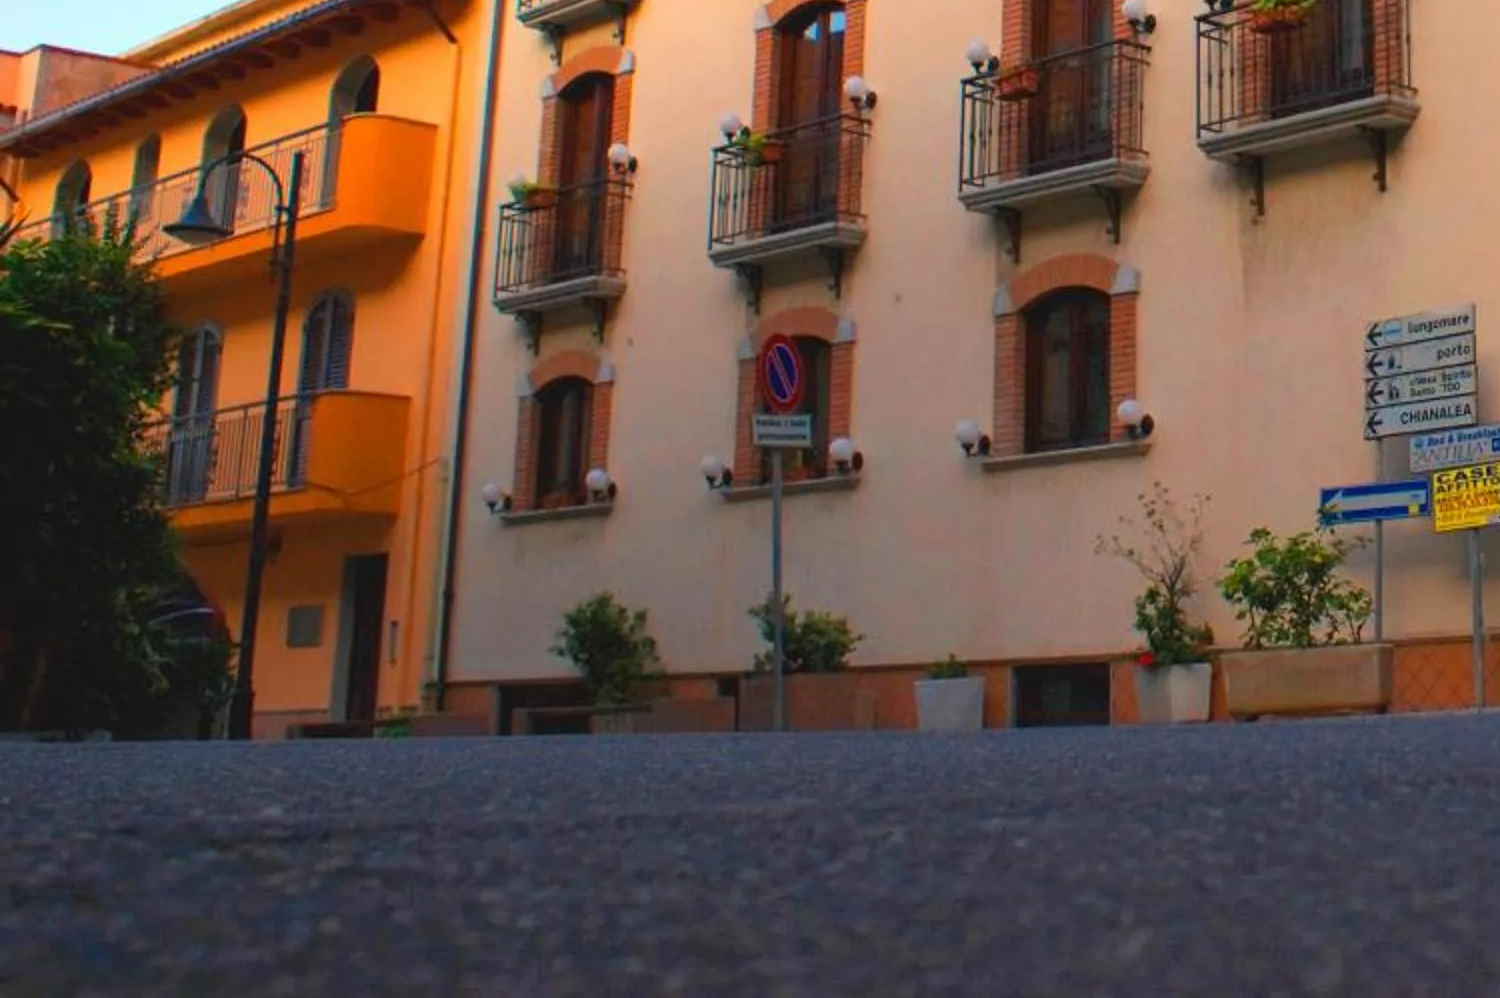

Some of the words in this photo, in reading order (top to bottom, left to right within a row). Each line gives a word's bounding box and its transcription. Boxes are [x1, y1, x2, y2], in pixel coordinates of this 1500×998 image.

[1408, 314, 1470, 335] lungomare
[1437, 343, 1472, 362] porto
[1400, 402, 1472, 426] CHIANALEA
[1436, 465, 1500, 483] CASE
[1435, 477, 1500, 493] AFFITTO
